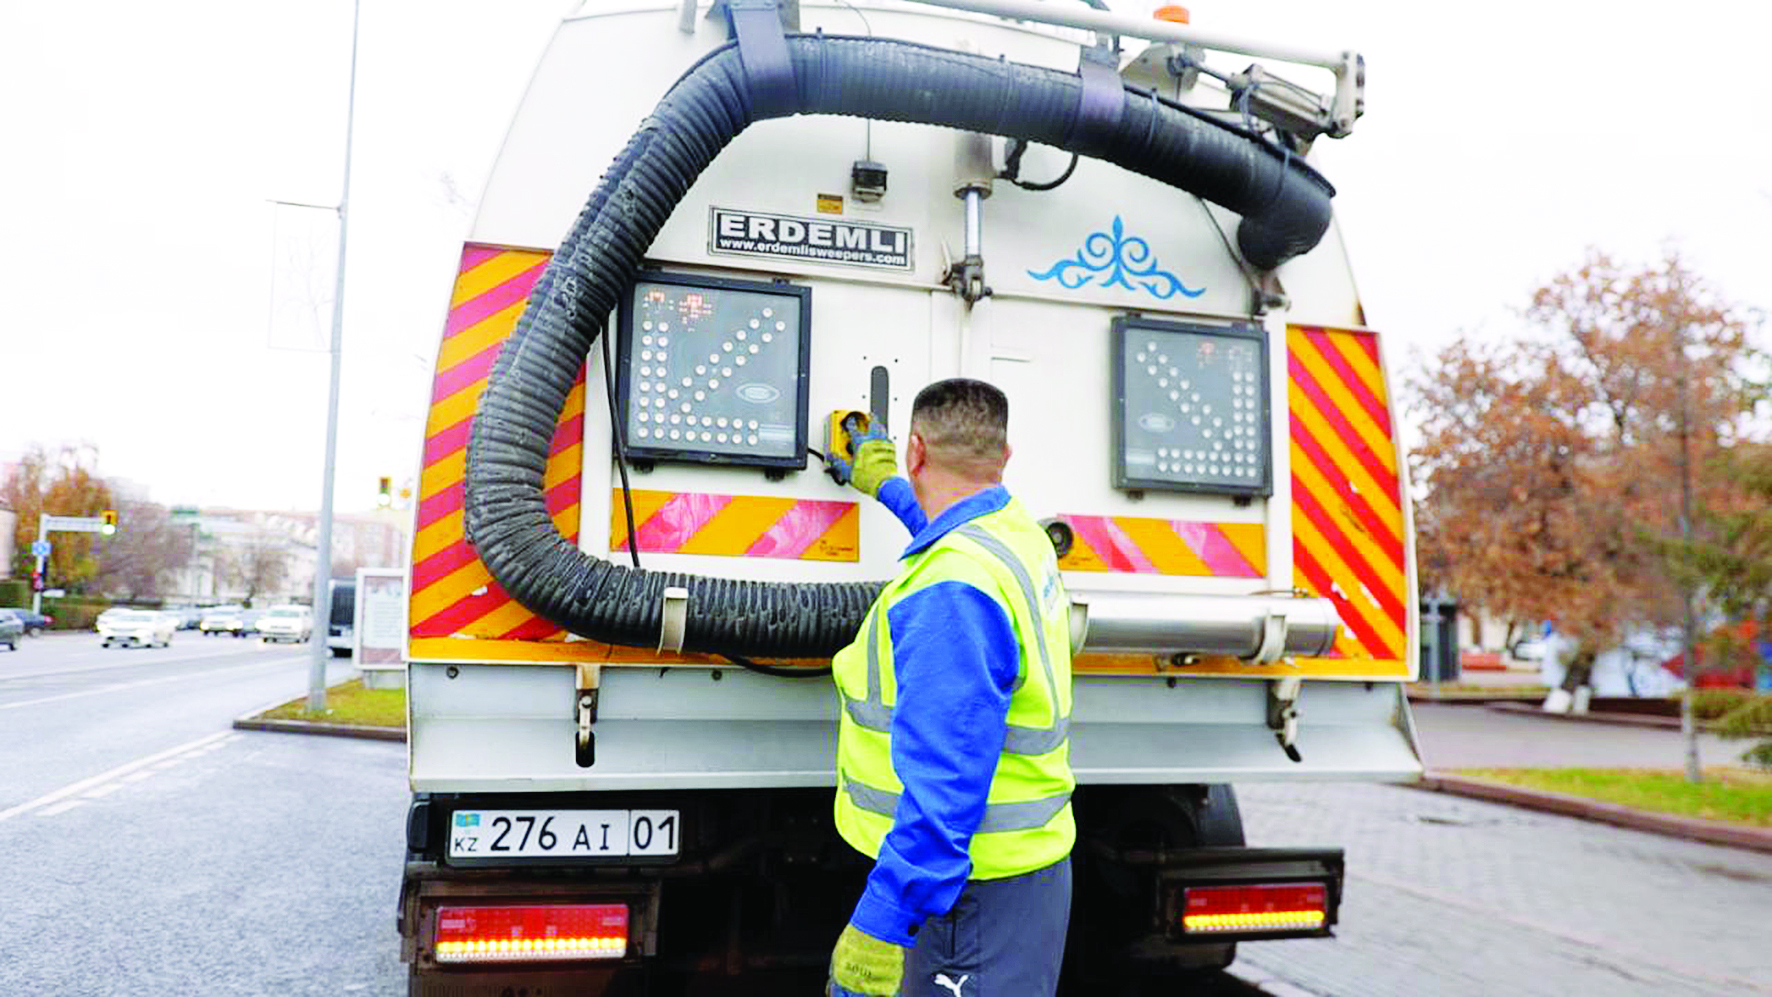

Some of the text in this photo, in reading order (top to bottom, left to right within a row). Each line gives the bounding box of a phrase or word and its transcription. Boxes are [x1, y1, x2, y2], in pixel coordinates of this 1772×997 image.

[720, 214, 905, 253] ERDEMLI
[719, 239, 905, 265] www.erdemlisweepers.com
[454, 838, 478, 852] KZ
[490, 816, 676, 851] 276 AI 01
